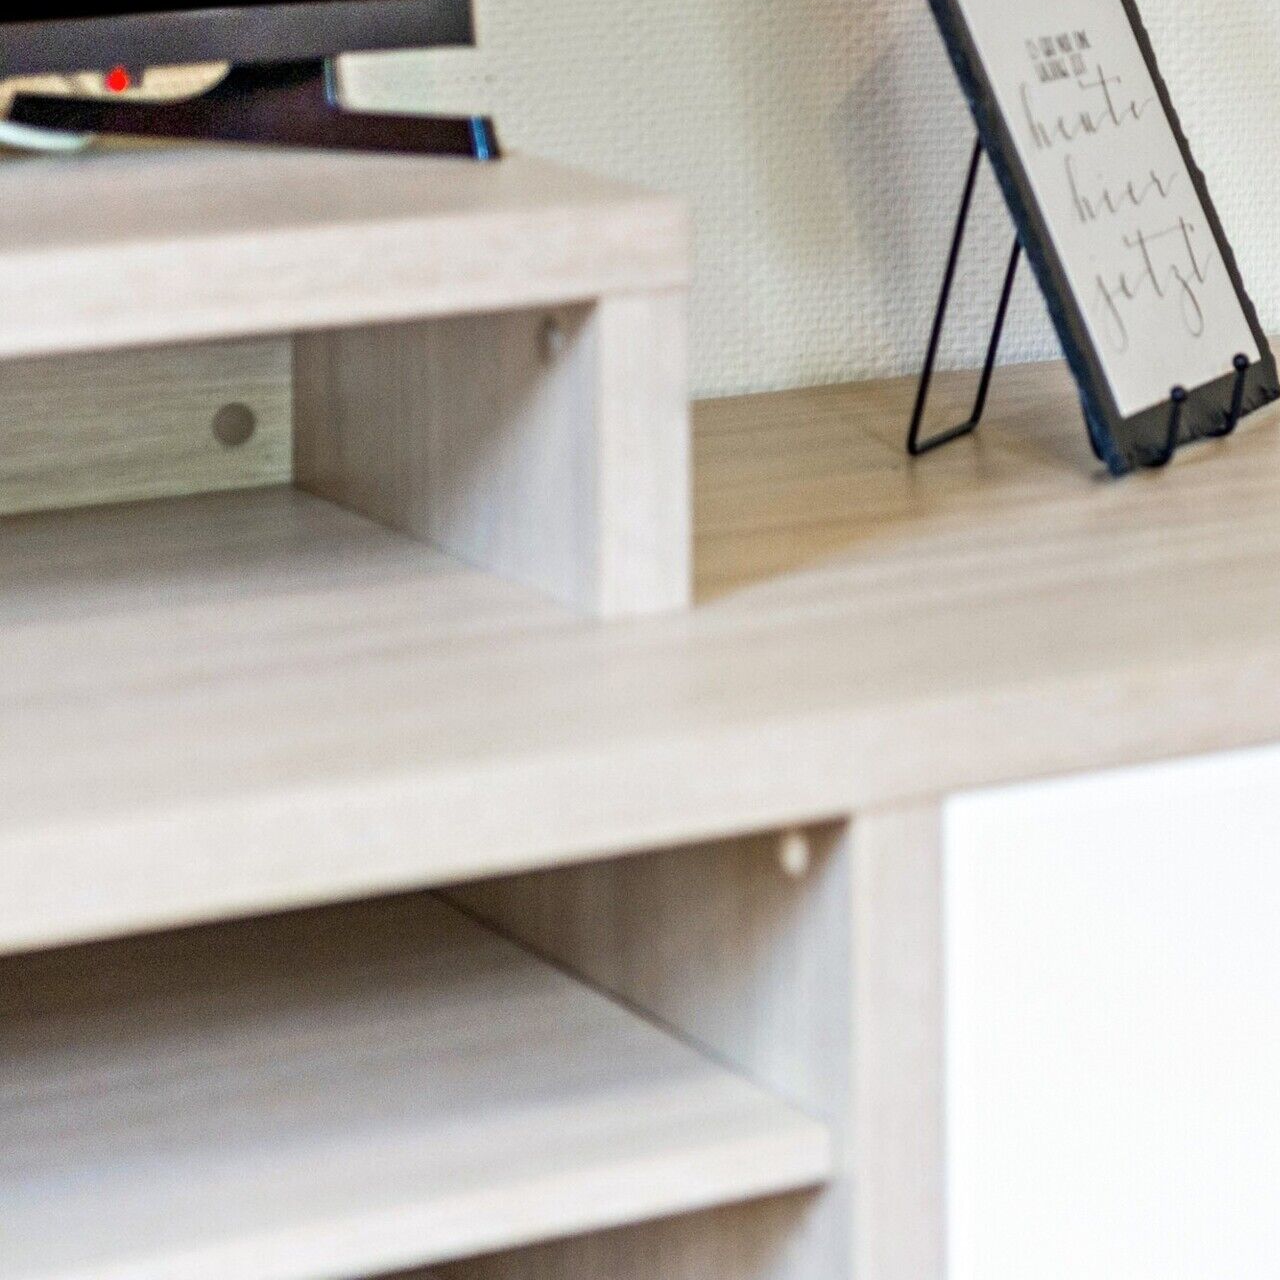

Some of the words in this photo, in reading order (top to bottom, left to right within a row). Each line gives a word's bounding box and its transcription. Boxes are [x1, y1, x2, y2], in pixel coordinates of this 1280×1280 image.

[1018, 63, 1155, 150] heute
[1064, 153, 1179, 223] hier
[1095, 216, 1213, 353] jetzt
